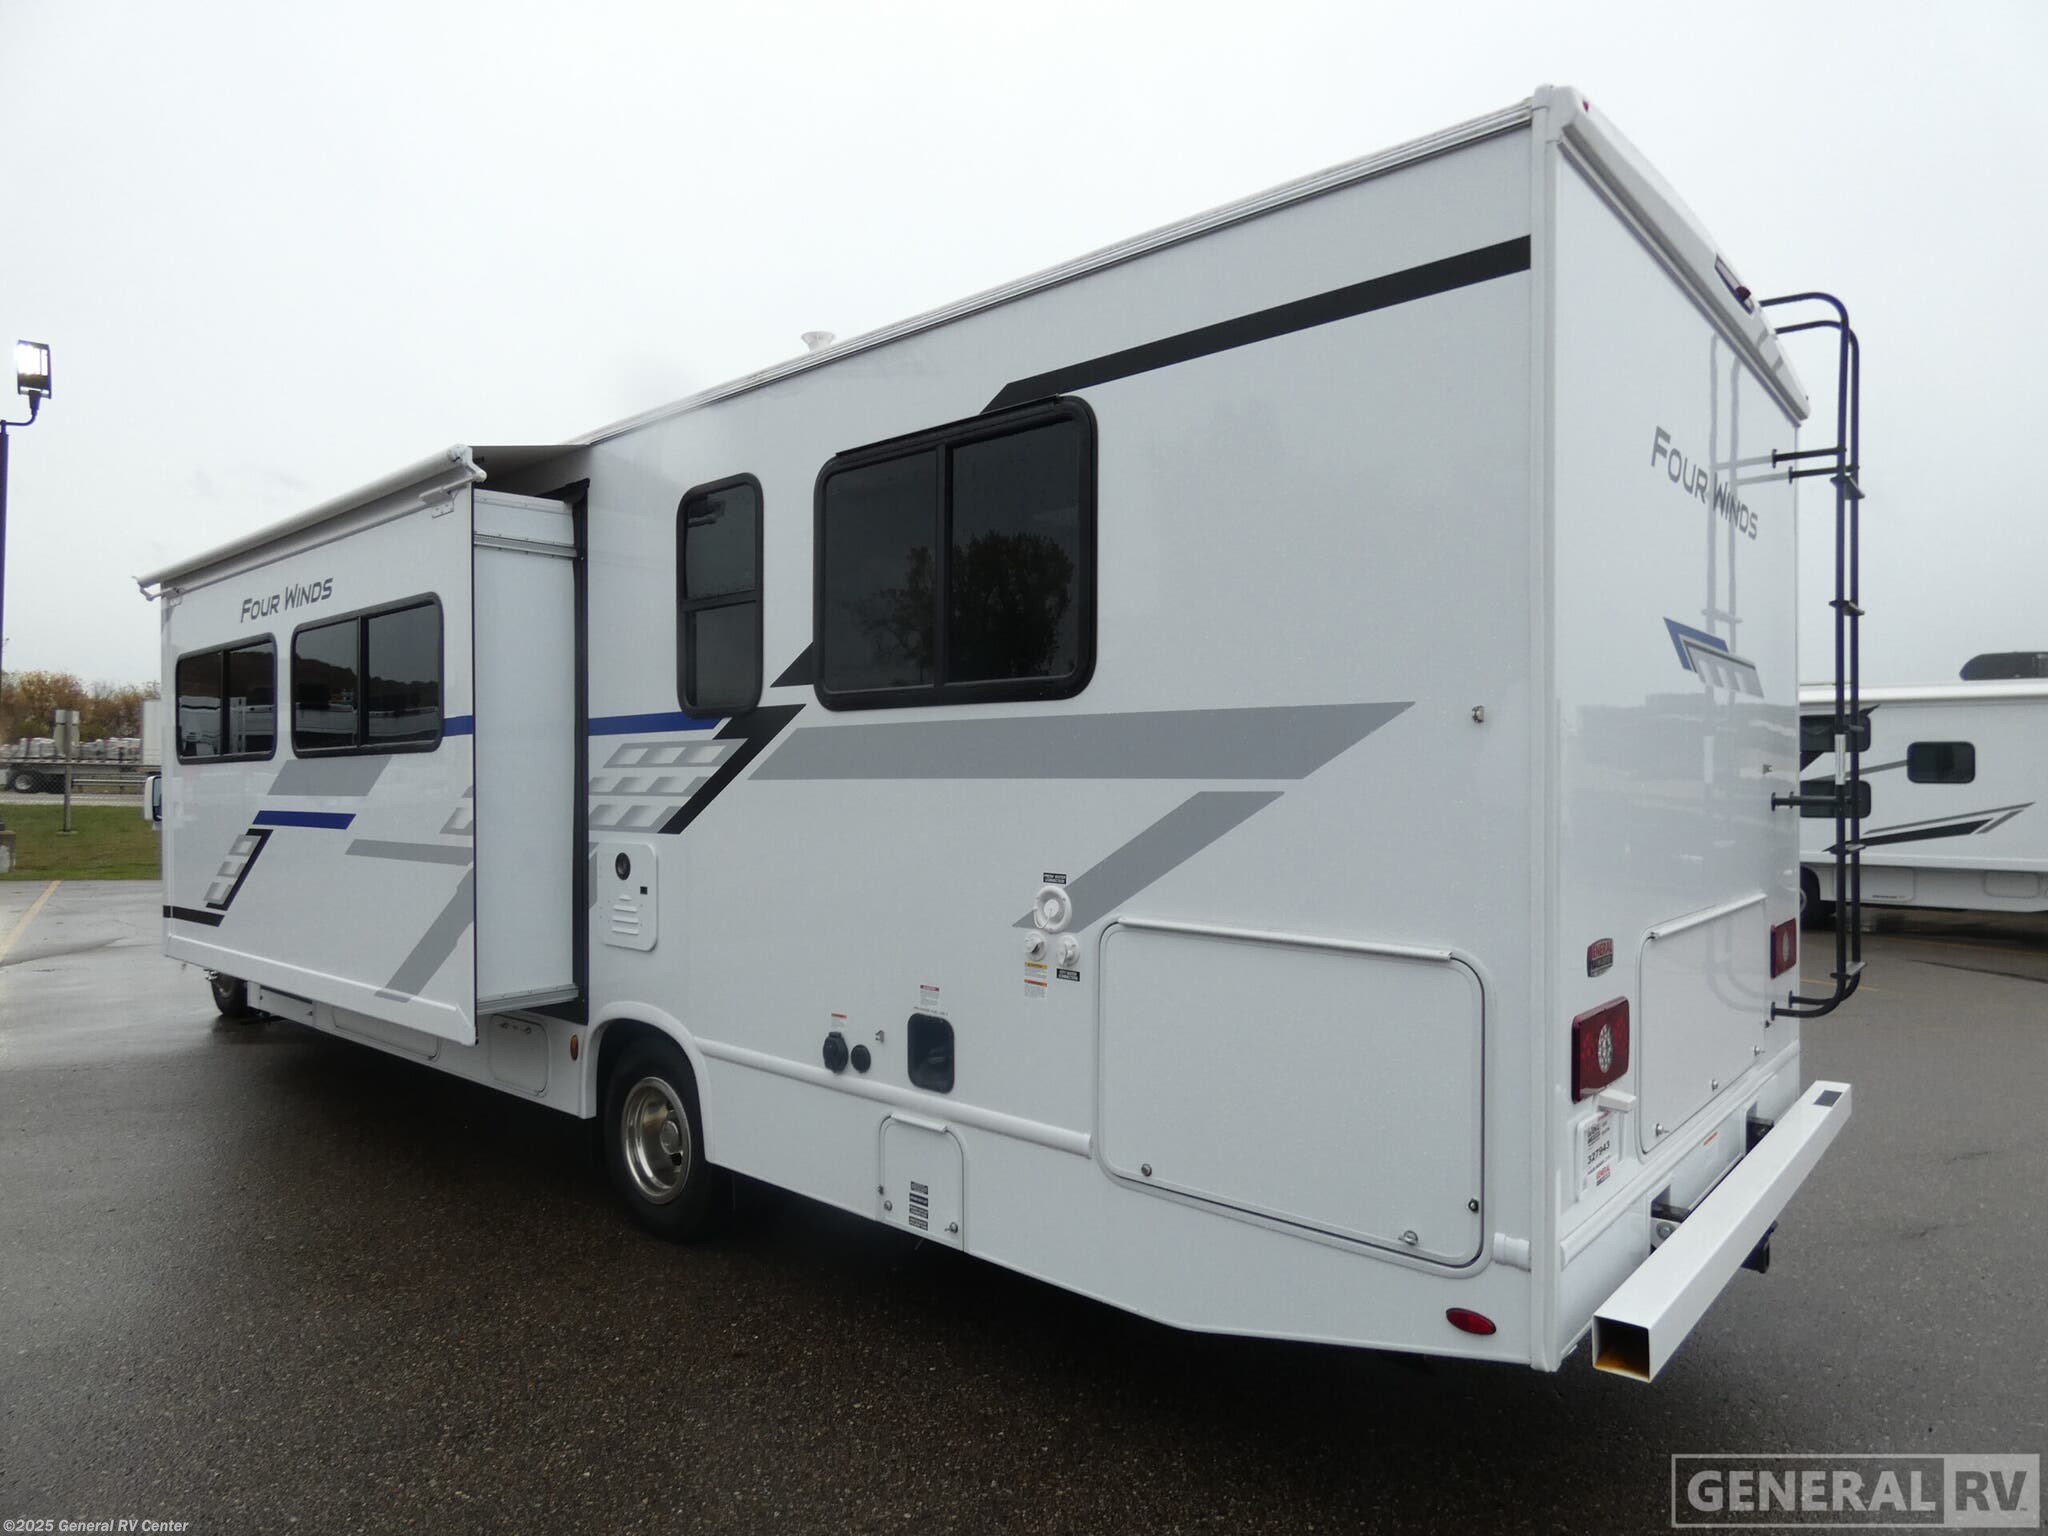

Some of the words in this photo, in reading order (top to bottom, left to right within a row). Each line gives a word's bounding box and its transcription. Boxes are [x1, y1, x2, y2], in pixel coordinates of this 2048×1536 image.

[1650, 425, 1709, 505] FOUR
[1712, 471, 1759, 541] WINDS
[240, 593, 281, 624] FOUR
[284, 578, 334, 611] WINDS
